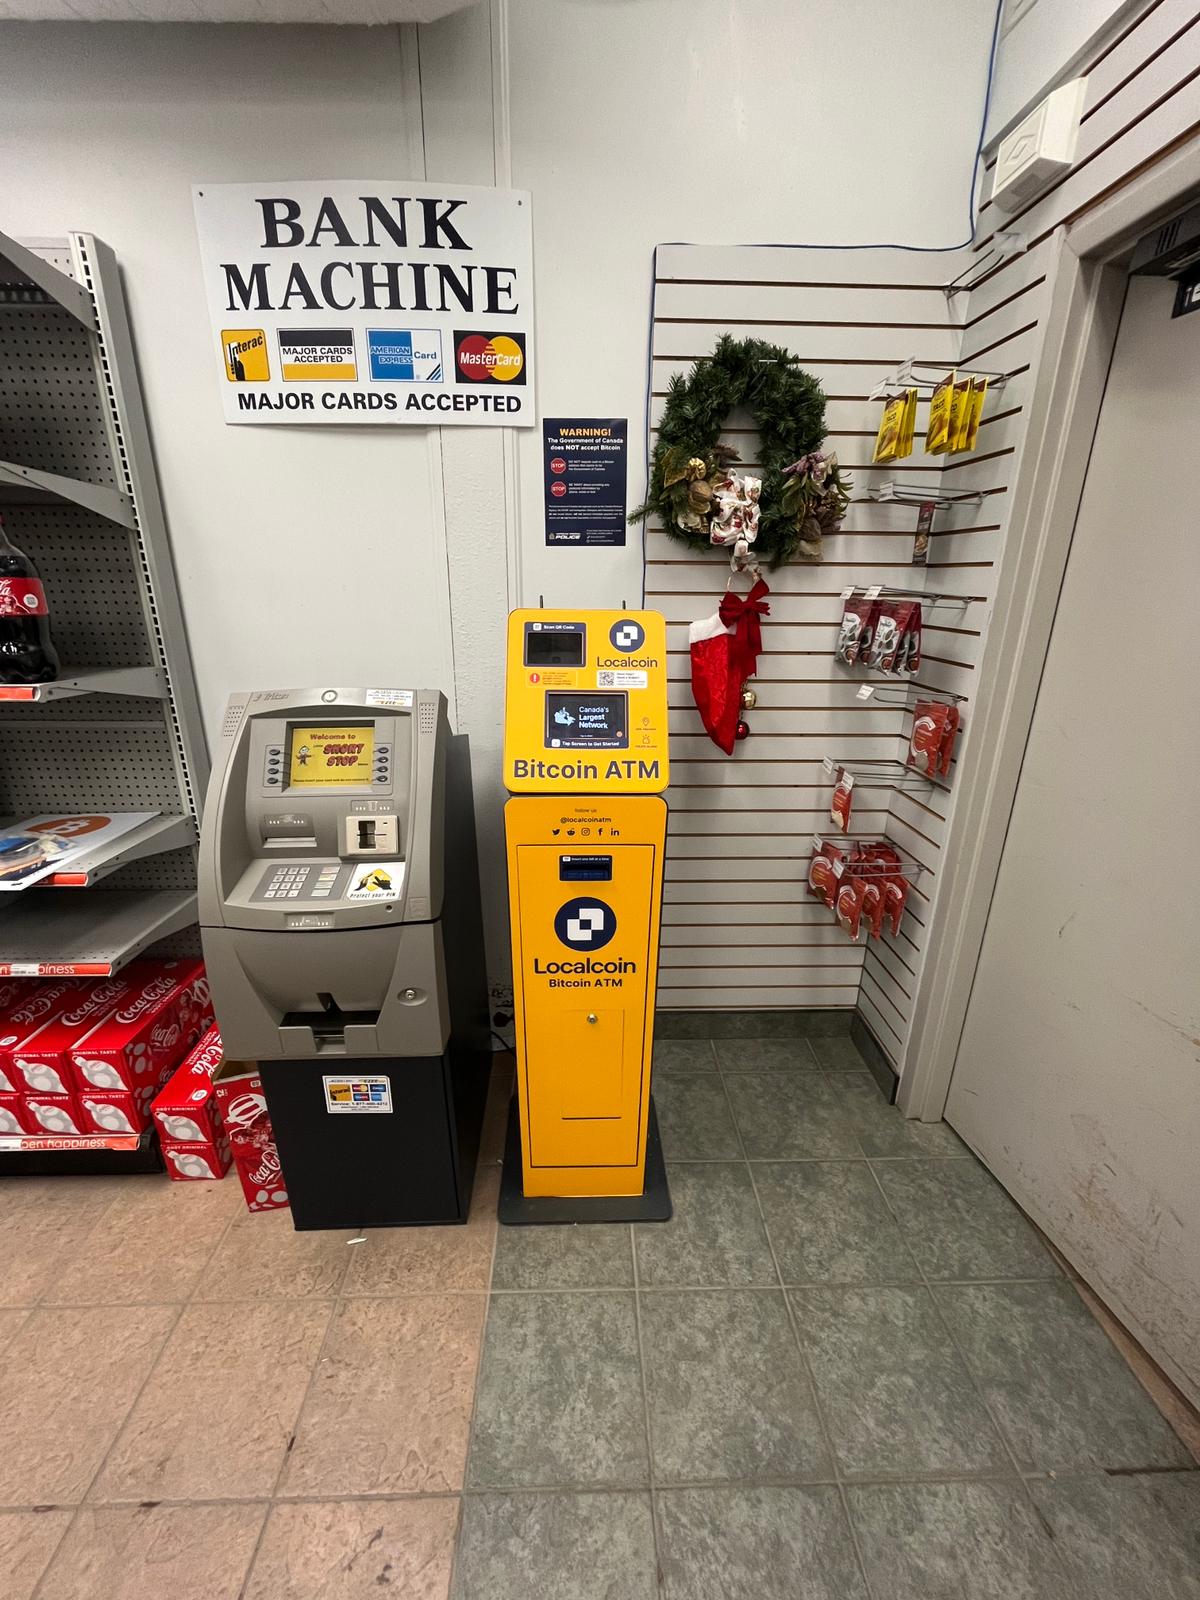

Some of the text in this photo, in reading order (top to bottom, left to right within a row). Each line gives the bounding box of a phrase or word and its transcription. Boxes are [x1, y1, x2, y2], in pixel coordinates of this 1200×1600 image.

[255, 196, 473, 250] BANK
[220, 261, 519, 315] MACHINE
[228, 335, 263, 362] Interac
[282, 347, 353, 355] MAJOR CARDS
[370, 346, 411, 354] AMERICAN
[294, 355, 343, 363] ACCEPTED
[379, 356, 413, 364] EXPRESS
[414, 351, 437, 360] Card
[460, 352, 521, 366] MasterCard
[238, 392, 522, 412] MAJOR CARDS ACCEPTED
[560, 428, 611, 436] WARNING!
[597, 656, 658, 668] Localcoin
[579, 721, 608, 729] Network
[323, 743, 364, 755] SHORT
[326, 755, 359, 766] STOP
[514, 759, 660, 779] Bitcoin ATM
[534, 957, 636, 974] Localcoin
[549, 978, 623, 988] Bitcoin ATM
[116, 977, 176, 1024] Coca-Cola
[21, 1138, 106, 1149] pen happiness
